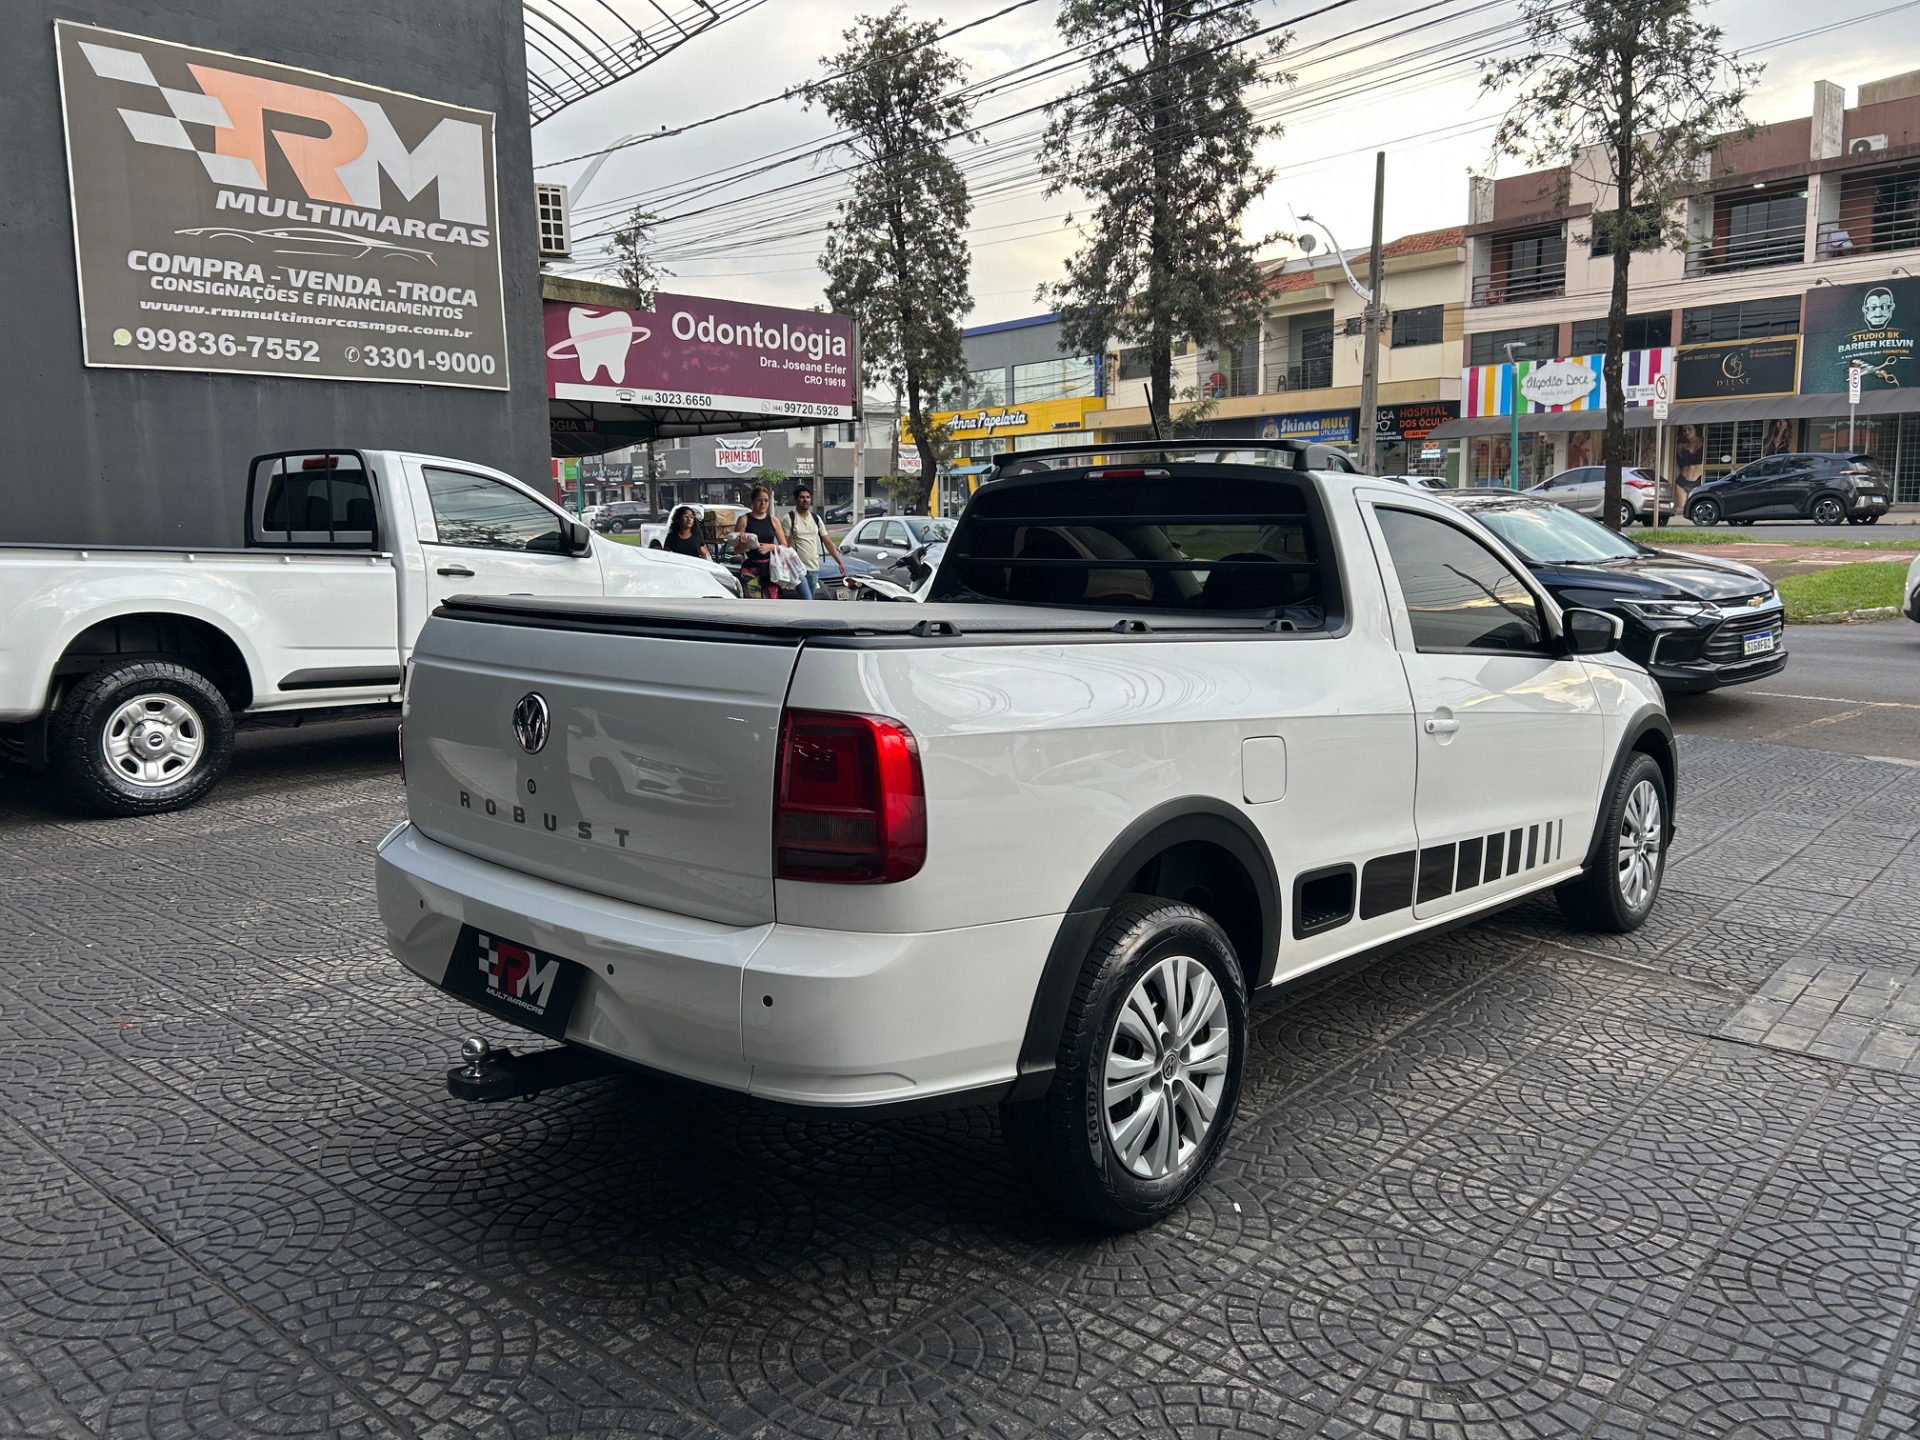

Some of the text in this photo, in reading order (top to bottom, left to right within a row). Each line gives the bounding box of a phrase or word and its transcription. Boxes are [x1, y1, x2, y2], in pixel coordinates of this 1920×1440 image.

[187, 63, 488, 227] RM
[215, 189, 491, 249] MULTIMARCAS
[127, 249, 265, 284] COMPRA
[287, 268, 383, 297] VENDA
[150, 275, 464, 320] CONSIGNAÇÕES E FINANCIAMENTOS
[139, 300, 474, 339] www.rmmultimarcasmga.com.br
[671, 310, 848, 361] Odontologia
[1852, 331, 1900, 342] STUDIO BK
[135, 326, 496, 376] 99836-7552 3301-9000
[1838, 339, 1914, 353] BARBER KELVIN
[759, 356, 848, 376] Dra. Joseane Erler
[804, 374, 847, 388] CRO 19618
[1526, 374, 1590, 391] Algodão Doce
[641, 392, 712, 408] (44) 3023.6650
[772, 402, 840, 418] (44) 99720.5928
[947, 408, 1028, 435] Anna Papelaria
[1376, 409, 1395, 421] ICA
[1400, 405, 1448, 418] HOSPITAL
[1320, 428, 1351, 436] UTILIDADES
[1399, 419, 1417, 428] DOS
[719, 449, 761, 466] PRIMEBOI
[459, 790, 630, 848] ROBUST
[493, 941, 561, 1009] RM
[485, 986, 545, 1016] MULTIMARCAS
